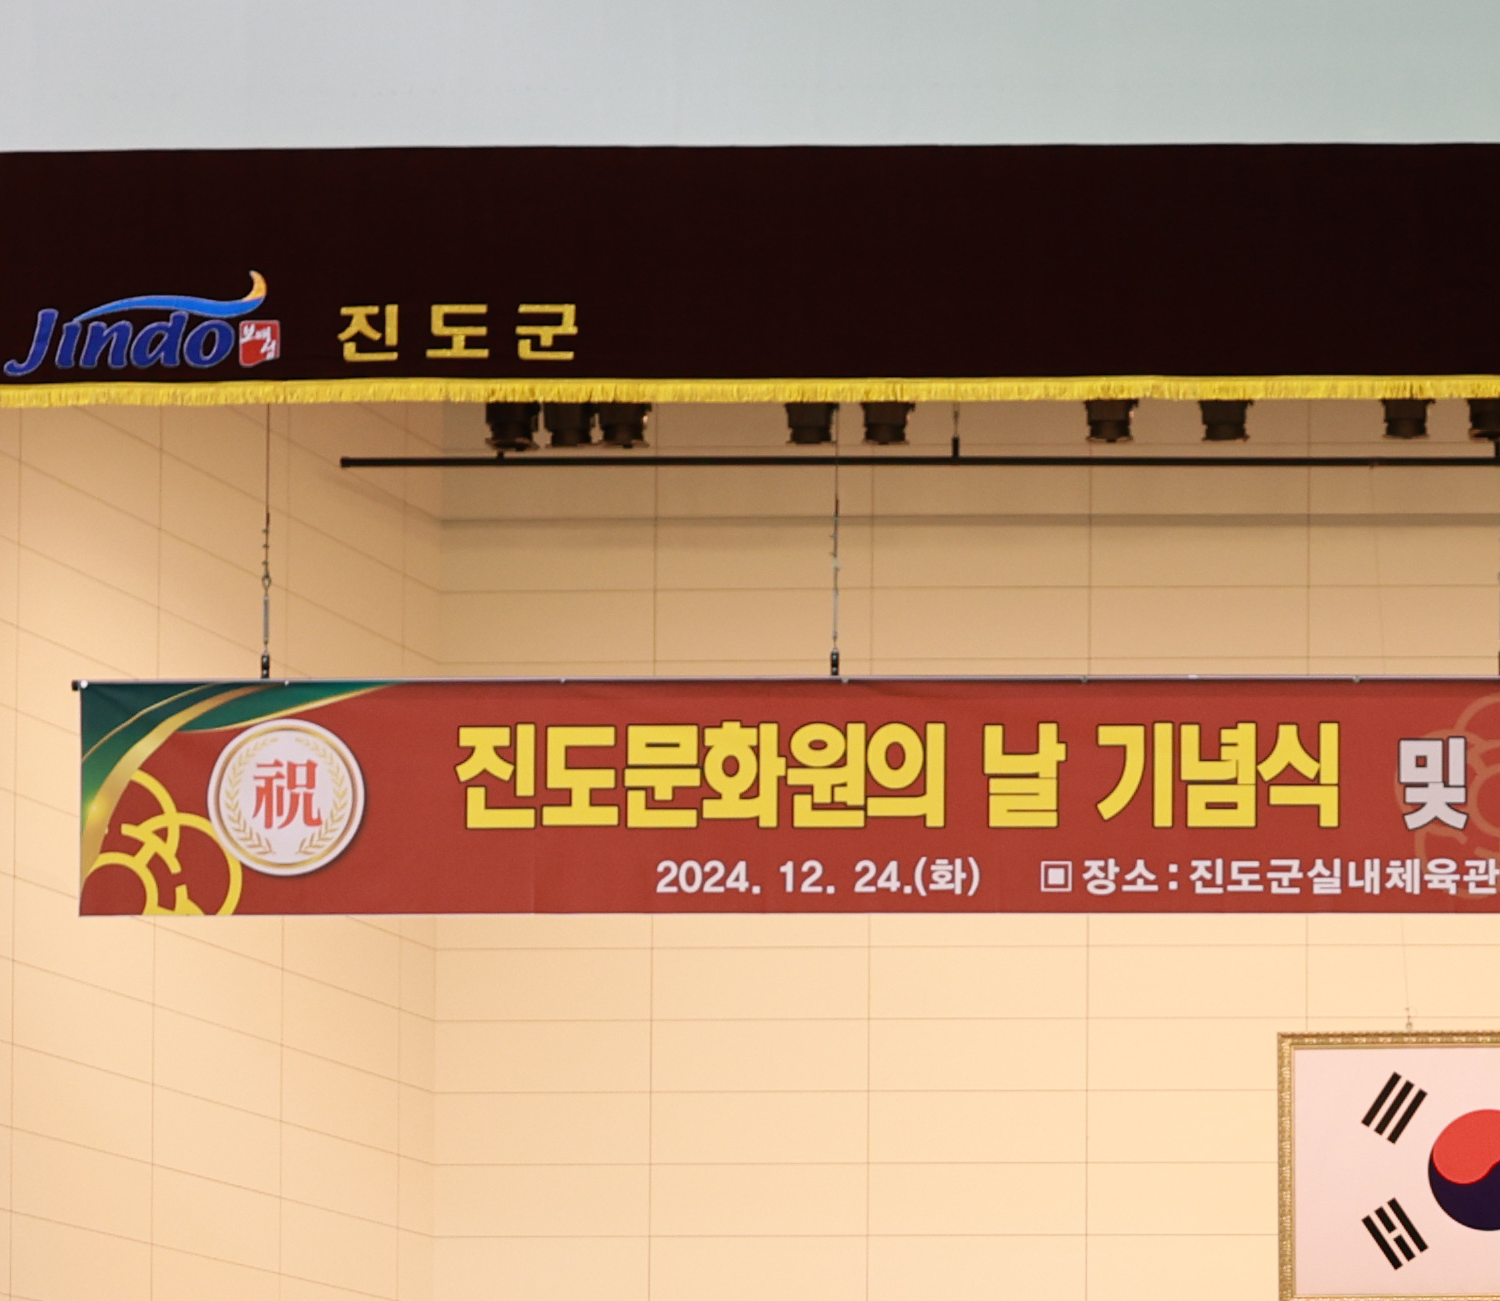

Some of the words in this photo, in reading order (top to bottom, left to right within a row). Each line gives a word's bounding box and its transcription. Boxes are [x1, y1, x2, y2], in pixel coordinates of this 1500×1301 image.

[4, 307, 236, 376] Jindo
[339, 304, 579, 363] 진도군
[255, 761, 323, 830] 祝
[456, 722, 947, 831] 진도문화원의
[984, 723, 1068, 830] 날
[1097, 722, 1341, 830] 기념식
[1398, 737, 1471, 832] 및
[657, 858, 762, 895] 2024.
[780, 859, 836, 895] 12.
